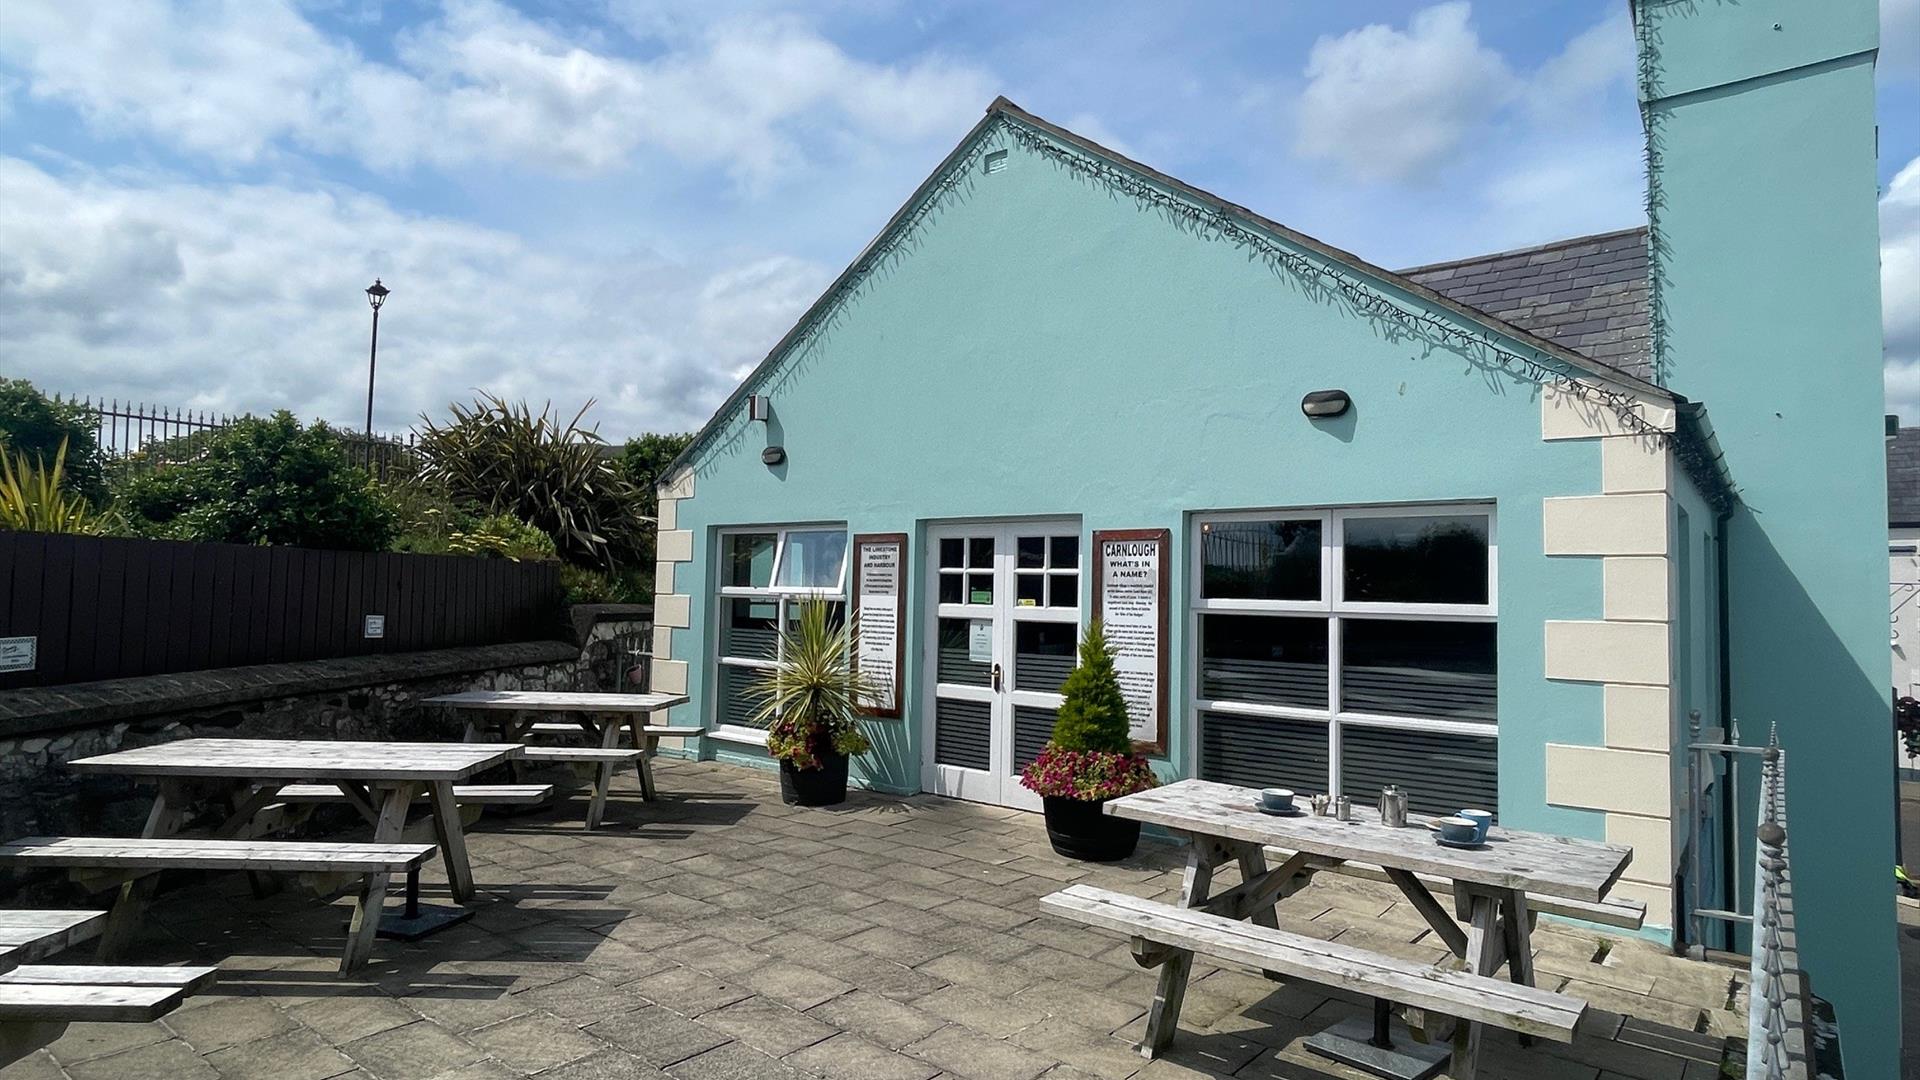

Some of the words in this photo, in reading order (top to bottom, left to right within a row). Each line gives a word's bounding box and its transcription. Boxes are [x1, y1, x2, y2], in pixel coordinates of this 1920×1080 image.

[1105, 543, 1156, 557] CARNLOUGH
[1109, 560, 1140, 568] WHAT'S
[1141, 560, 1151, 568] IN
[1112, 570, 1118, 578] A
[1119, 570, 1148, 578] NAME?
